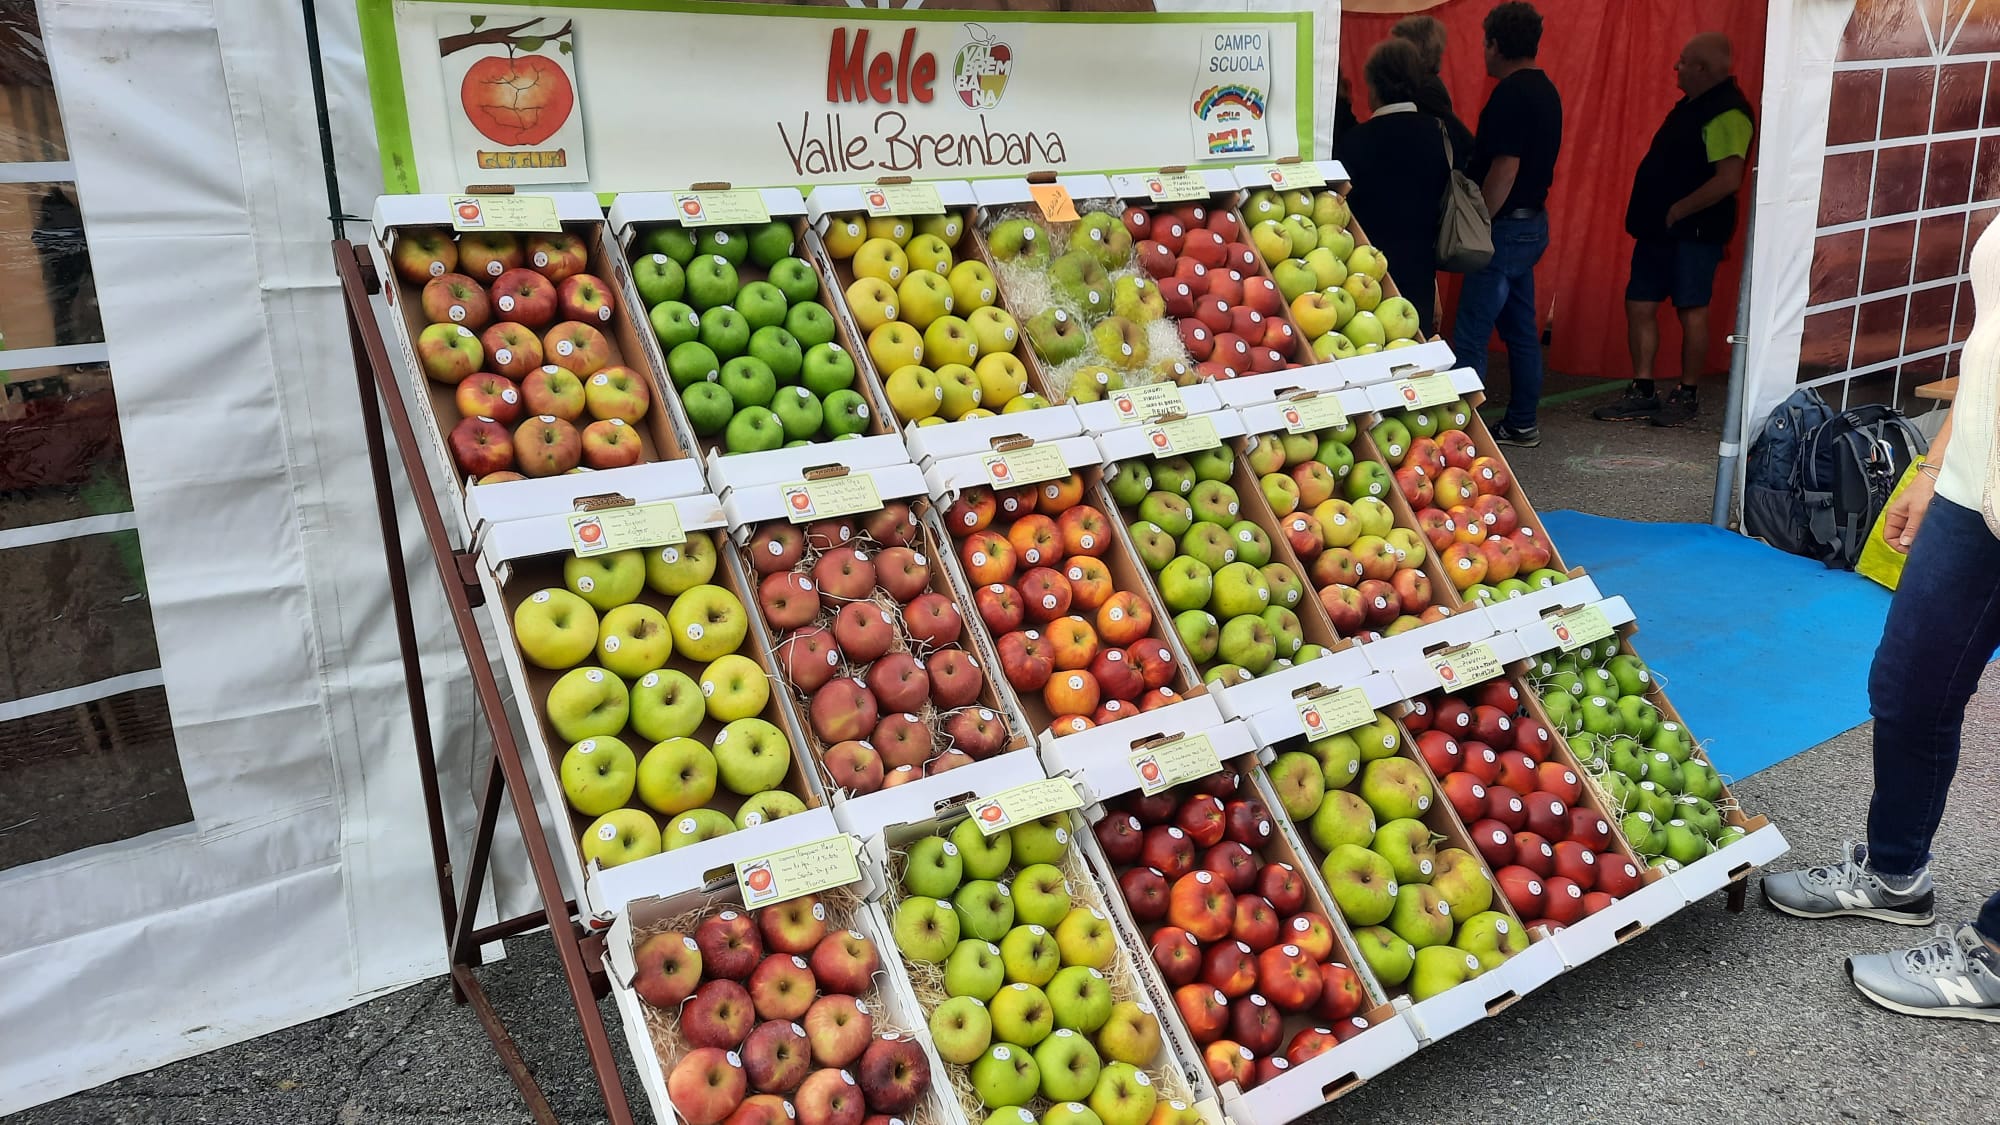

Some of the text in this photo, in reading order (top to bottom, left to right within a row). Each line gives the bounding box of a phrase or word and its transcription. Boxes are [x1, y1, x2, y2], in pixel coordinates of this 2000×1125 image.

[1214, 34, 1261, 51] CAMPO
[962, 46, 995, 62] VAL
[827, 26, 936, 104] Mele
[963, 60, 1009, 76] BREM
[1209, 56, 1264, 73] SCUOLA
[956, 75, 981, 91] BA
[971, 89, 998, 107] NA
[777, 111, 1066, 175] Valle Brembana
[960, 594, 992, 659] ASSOCIAZIONE
[1834, 888, 1874, 910] N
[1127, 931, 1168, 1010] ASSOCIAZIONE
[1933, 975, 1984, 1006] N
